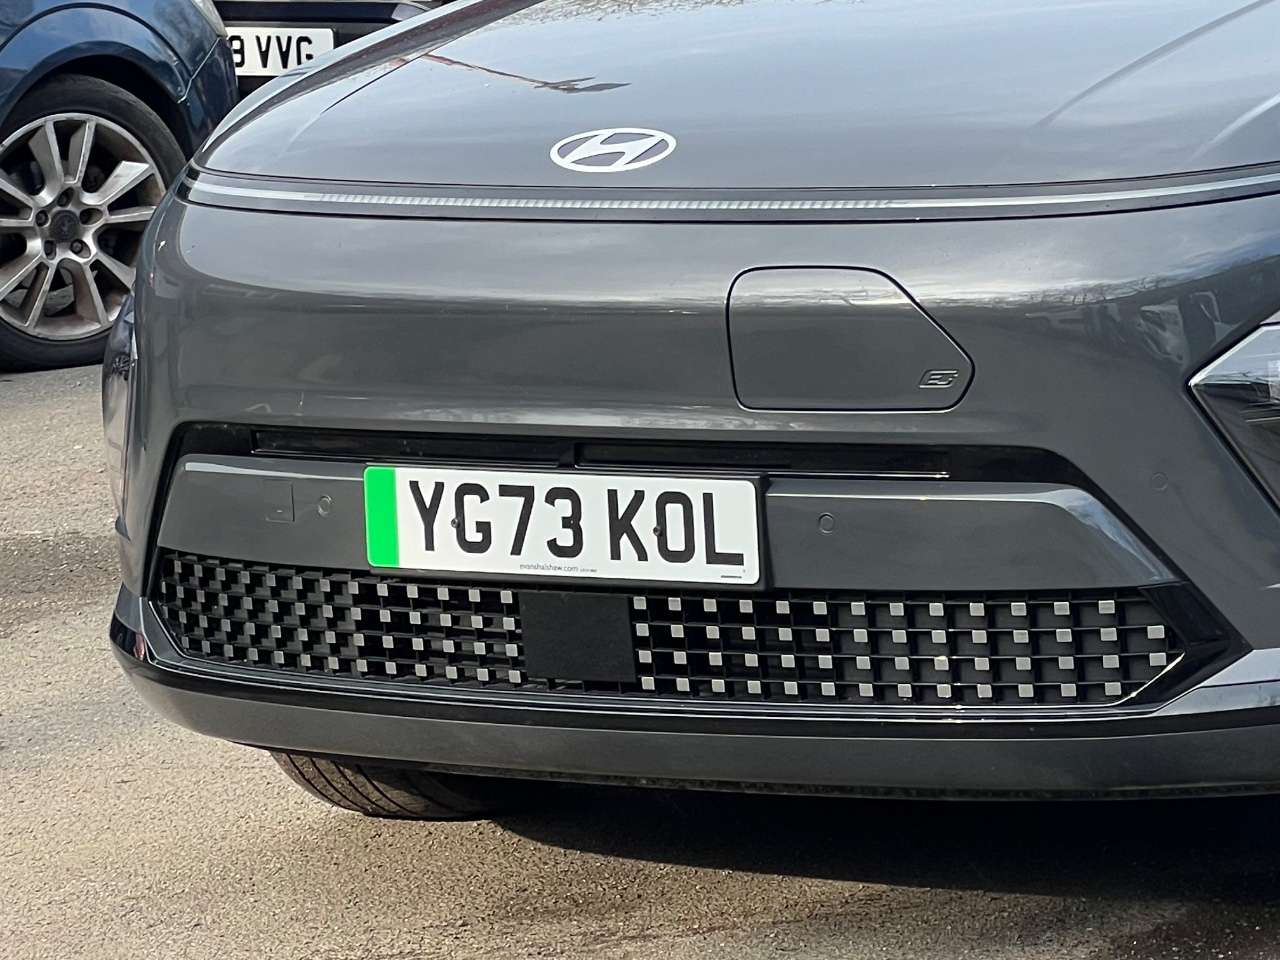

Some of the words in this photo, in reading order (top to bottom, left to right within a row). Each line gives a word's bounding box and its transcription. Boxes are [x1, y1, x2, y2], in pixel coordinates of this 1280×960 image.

[256, 35, 314, 69] VVG
[409, 480, 584, 558] YG73
[608, 488, 745, 566] KOL
